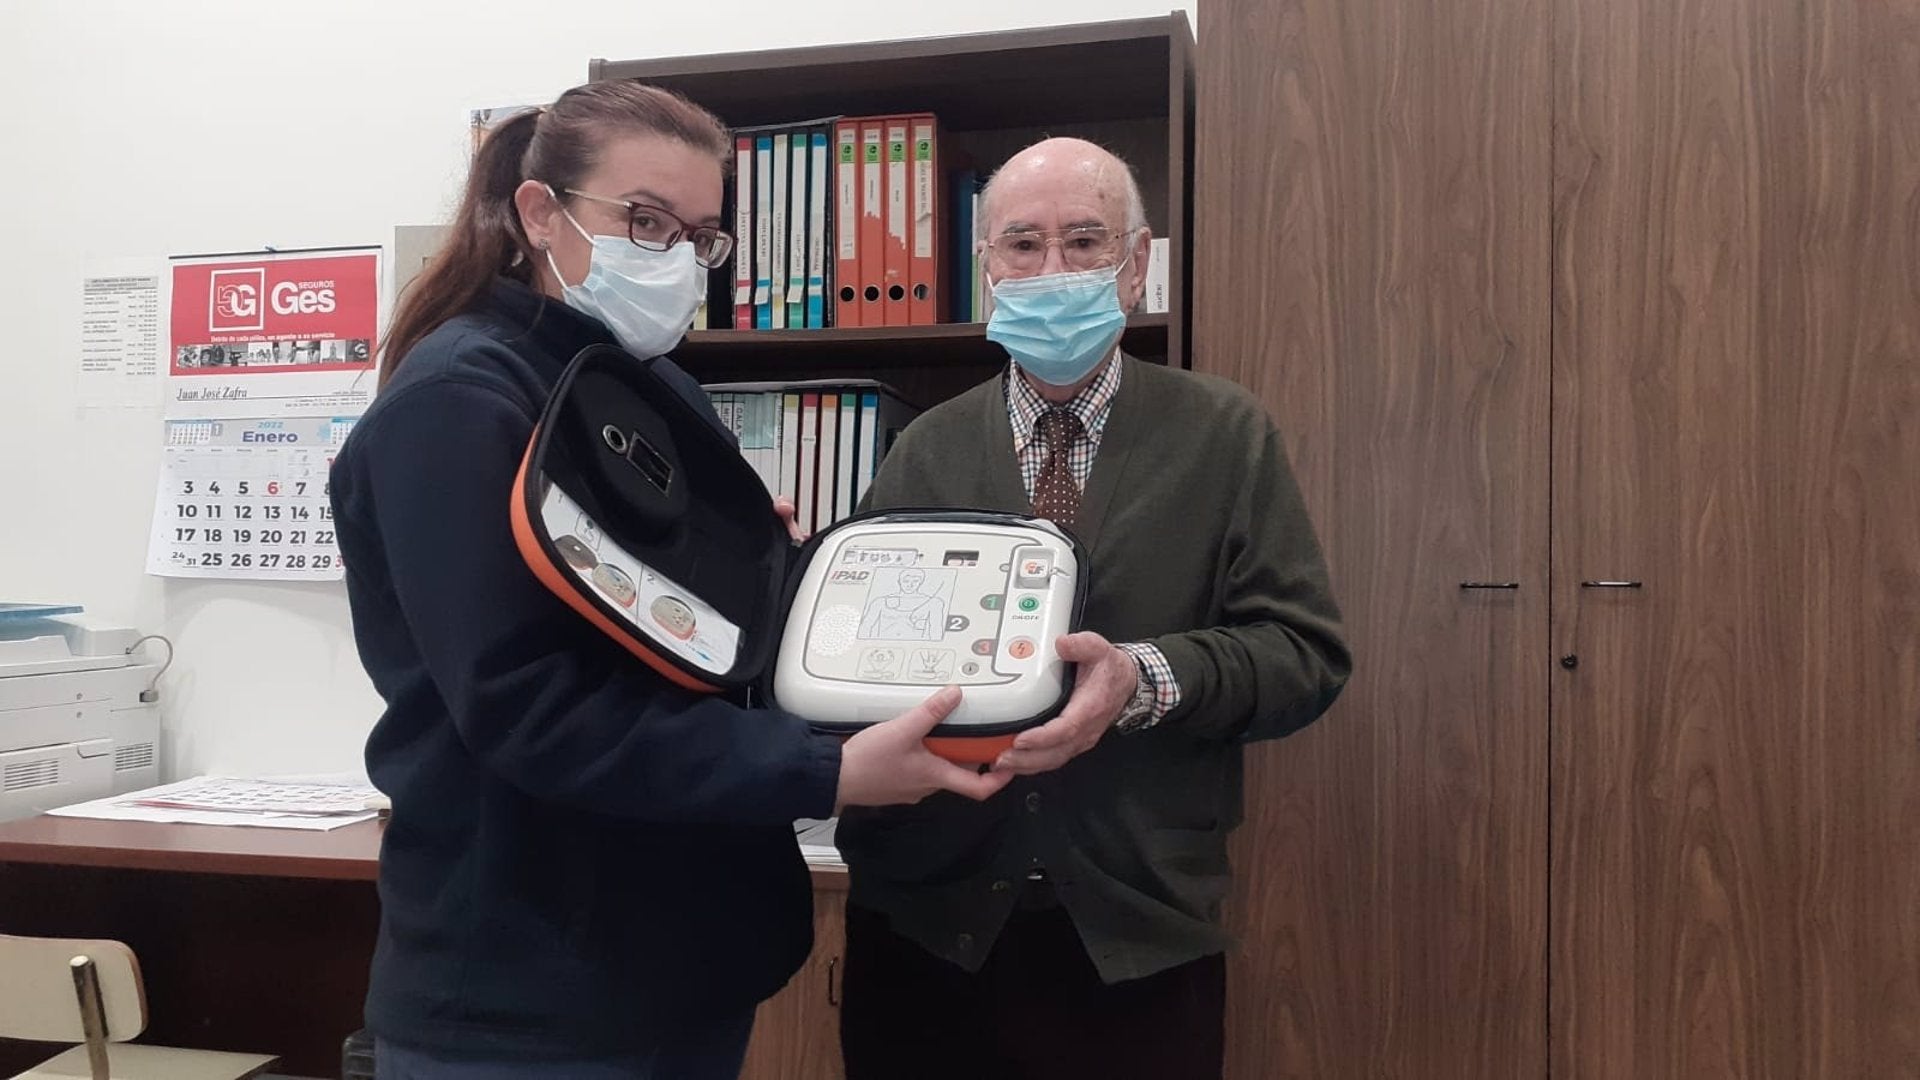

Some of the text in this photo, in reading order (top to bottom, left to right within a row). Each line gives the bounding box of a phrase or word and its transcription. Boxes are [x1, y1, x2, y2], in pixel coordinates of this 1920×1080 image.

[298, 280, 335, 289] SEGUROS
[271, 281, 336, 315] Ges
[176, 386, 247, 401] Juan José Zafra
[257, 421, 284, 429] 2022
[242, 431, 298, 443] Enero
[184, 481, 194, 494] 3
[209, 481, 220, 494] 4
[238, 481, 249, 494] 5
[267, 481, 279, 495] 6
[296, 482, 307, 495] 7
[177, 504, 333, 520] 10 11 12 13 14 15
[176, 528, 334, 544] 17 18 19 20 21 22
[172, 551, 185, 559] 24
[186, 558, 197, 566] 31
[202, 553, 223, 566] 25
[231, 554, 252, 567] 26
[259, 554, 281, 567] 27
[286, 555, 306, 568] 28
[312, 555, 331, 568] 29
[949, 617, 961, 630] 2
